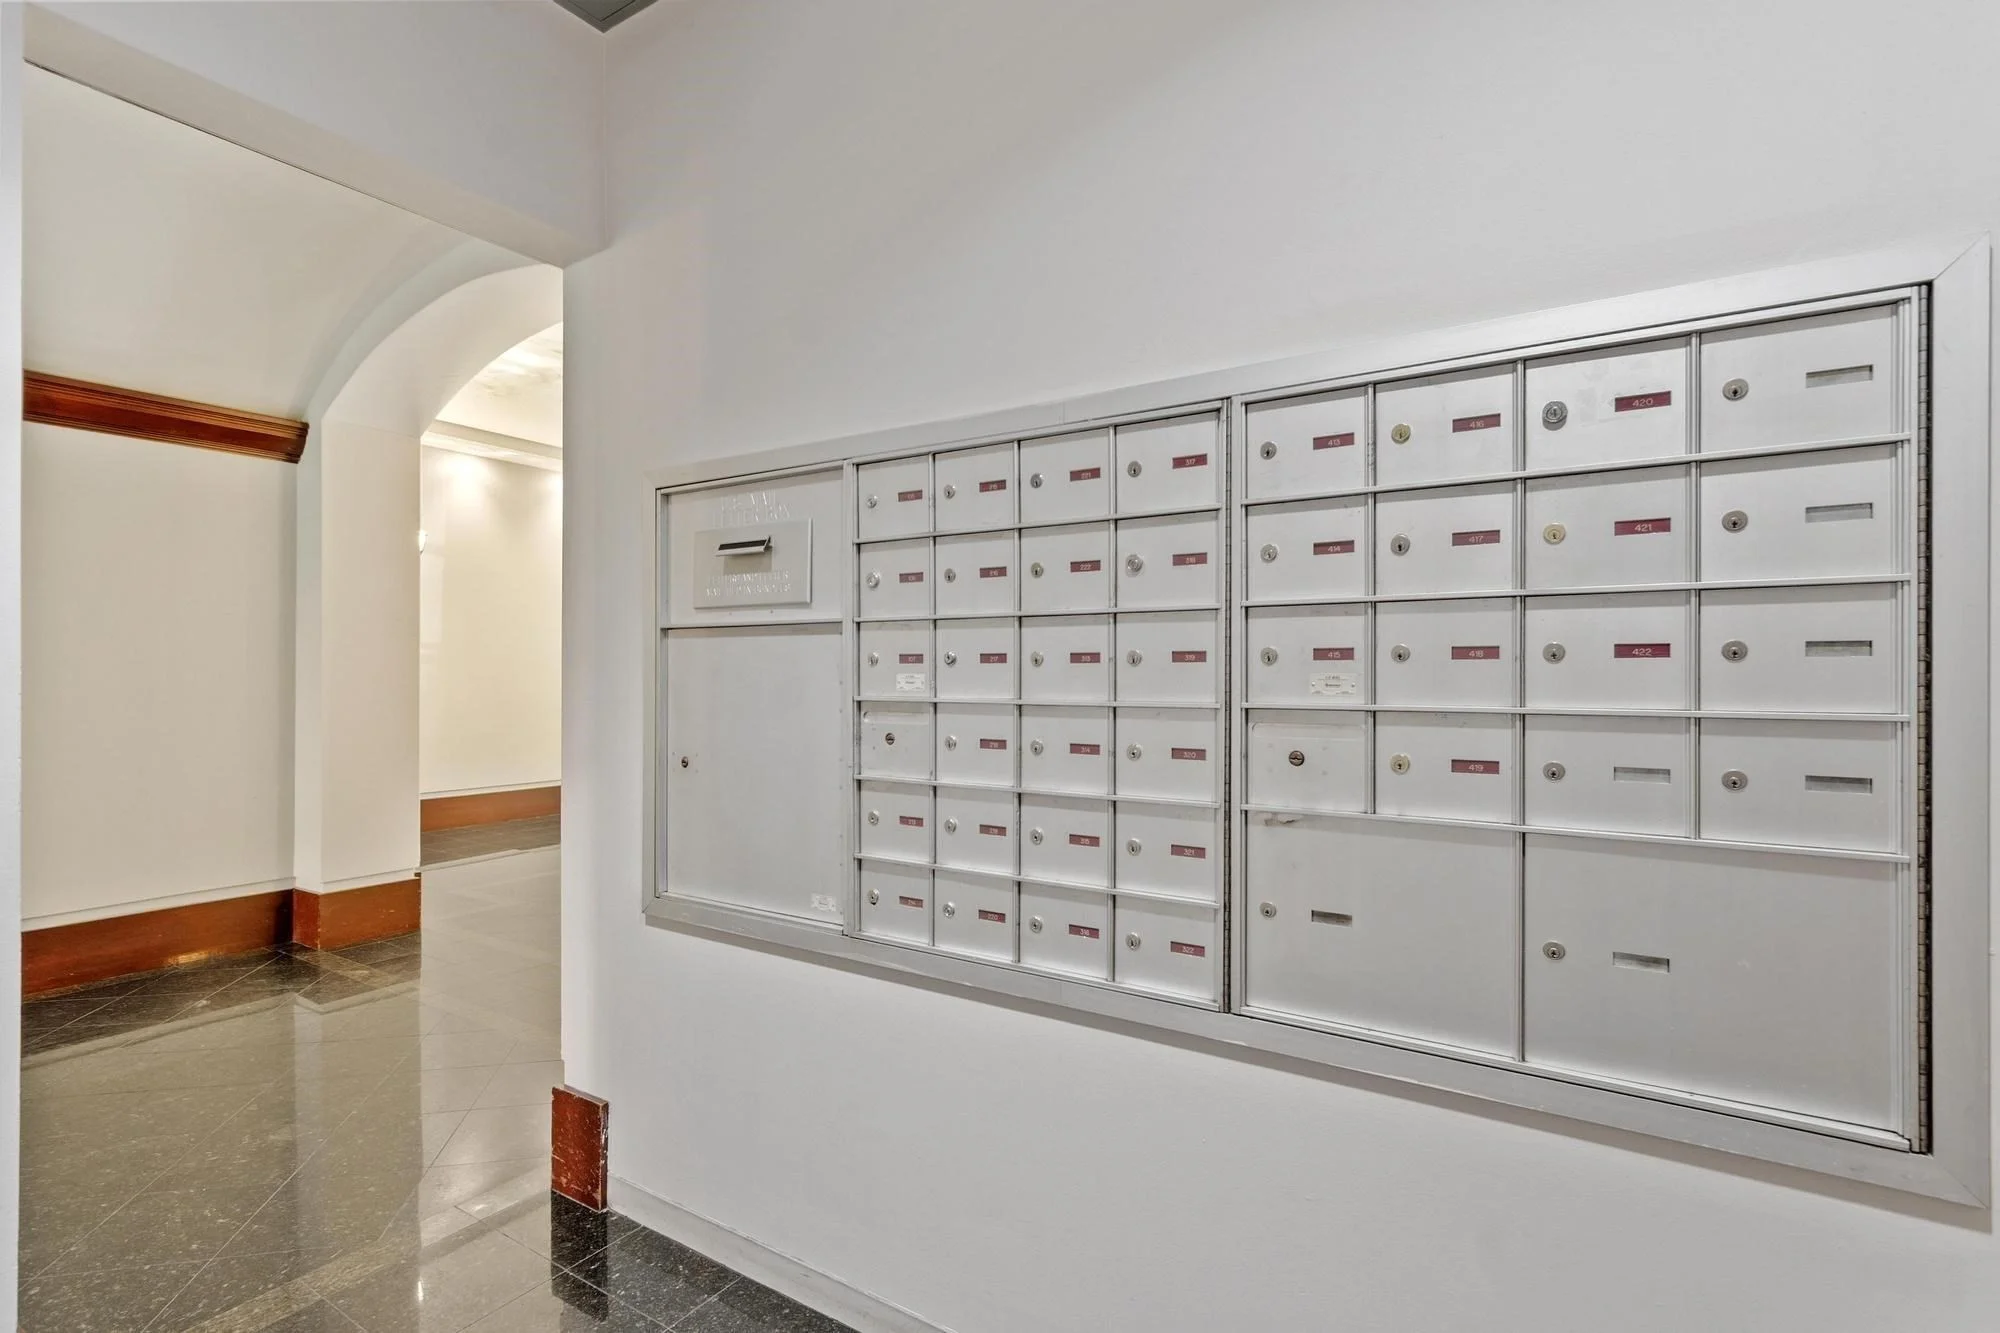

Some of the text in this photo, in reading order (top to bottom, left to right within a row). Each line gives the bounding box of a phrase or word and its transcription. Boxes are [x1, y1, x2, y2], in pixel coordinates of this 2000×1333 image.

[1632, 397, 1654, 408] 420
[1470, 420, 1485, 428] 416
[1327, 439, 1341, 447] 413
[1184, 458, 1196, 466] 317
[1634, 523, 1652, 532] 421
[1468, 535, 1484, 543] 417
[1327, 545, 1341, 553] 414
[1079, 563, 1091, 571] 222
[1327, 651, 1341, 659] 415
[1468, 650, 1484, 658] 418
[1631, 648, 1652, 656] 422
[1183, 751, 1197, 759] 320
[1183, 848, 1195, 856] 321
[1182, 945, 1195, 953] 322
